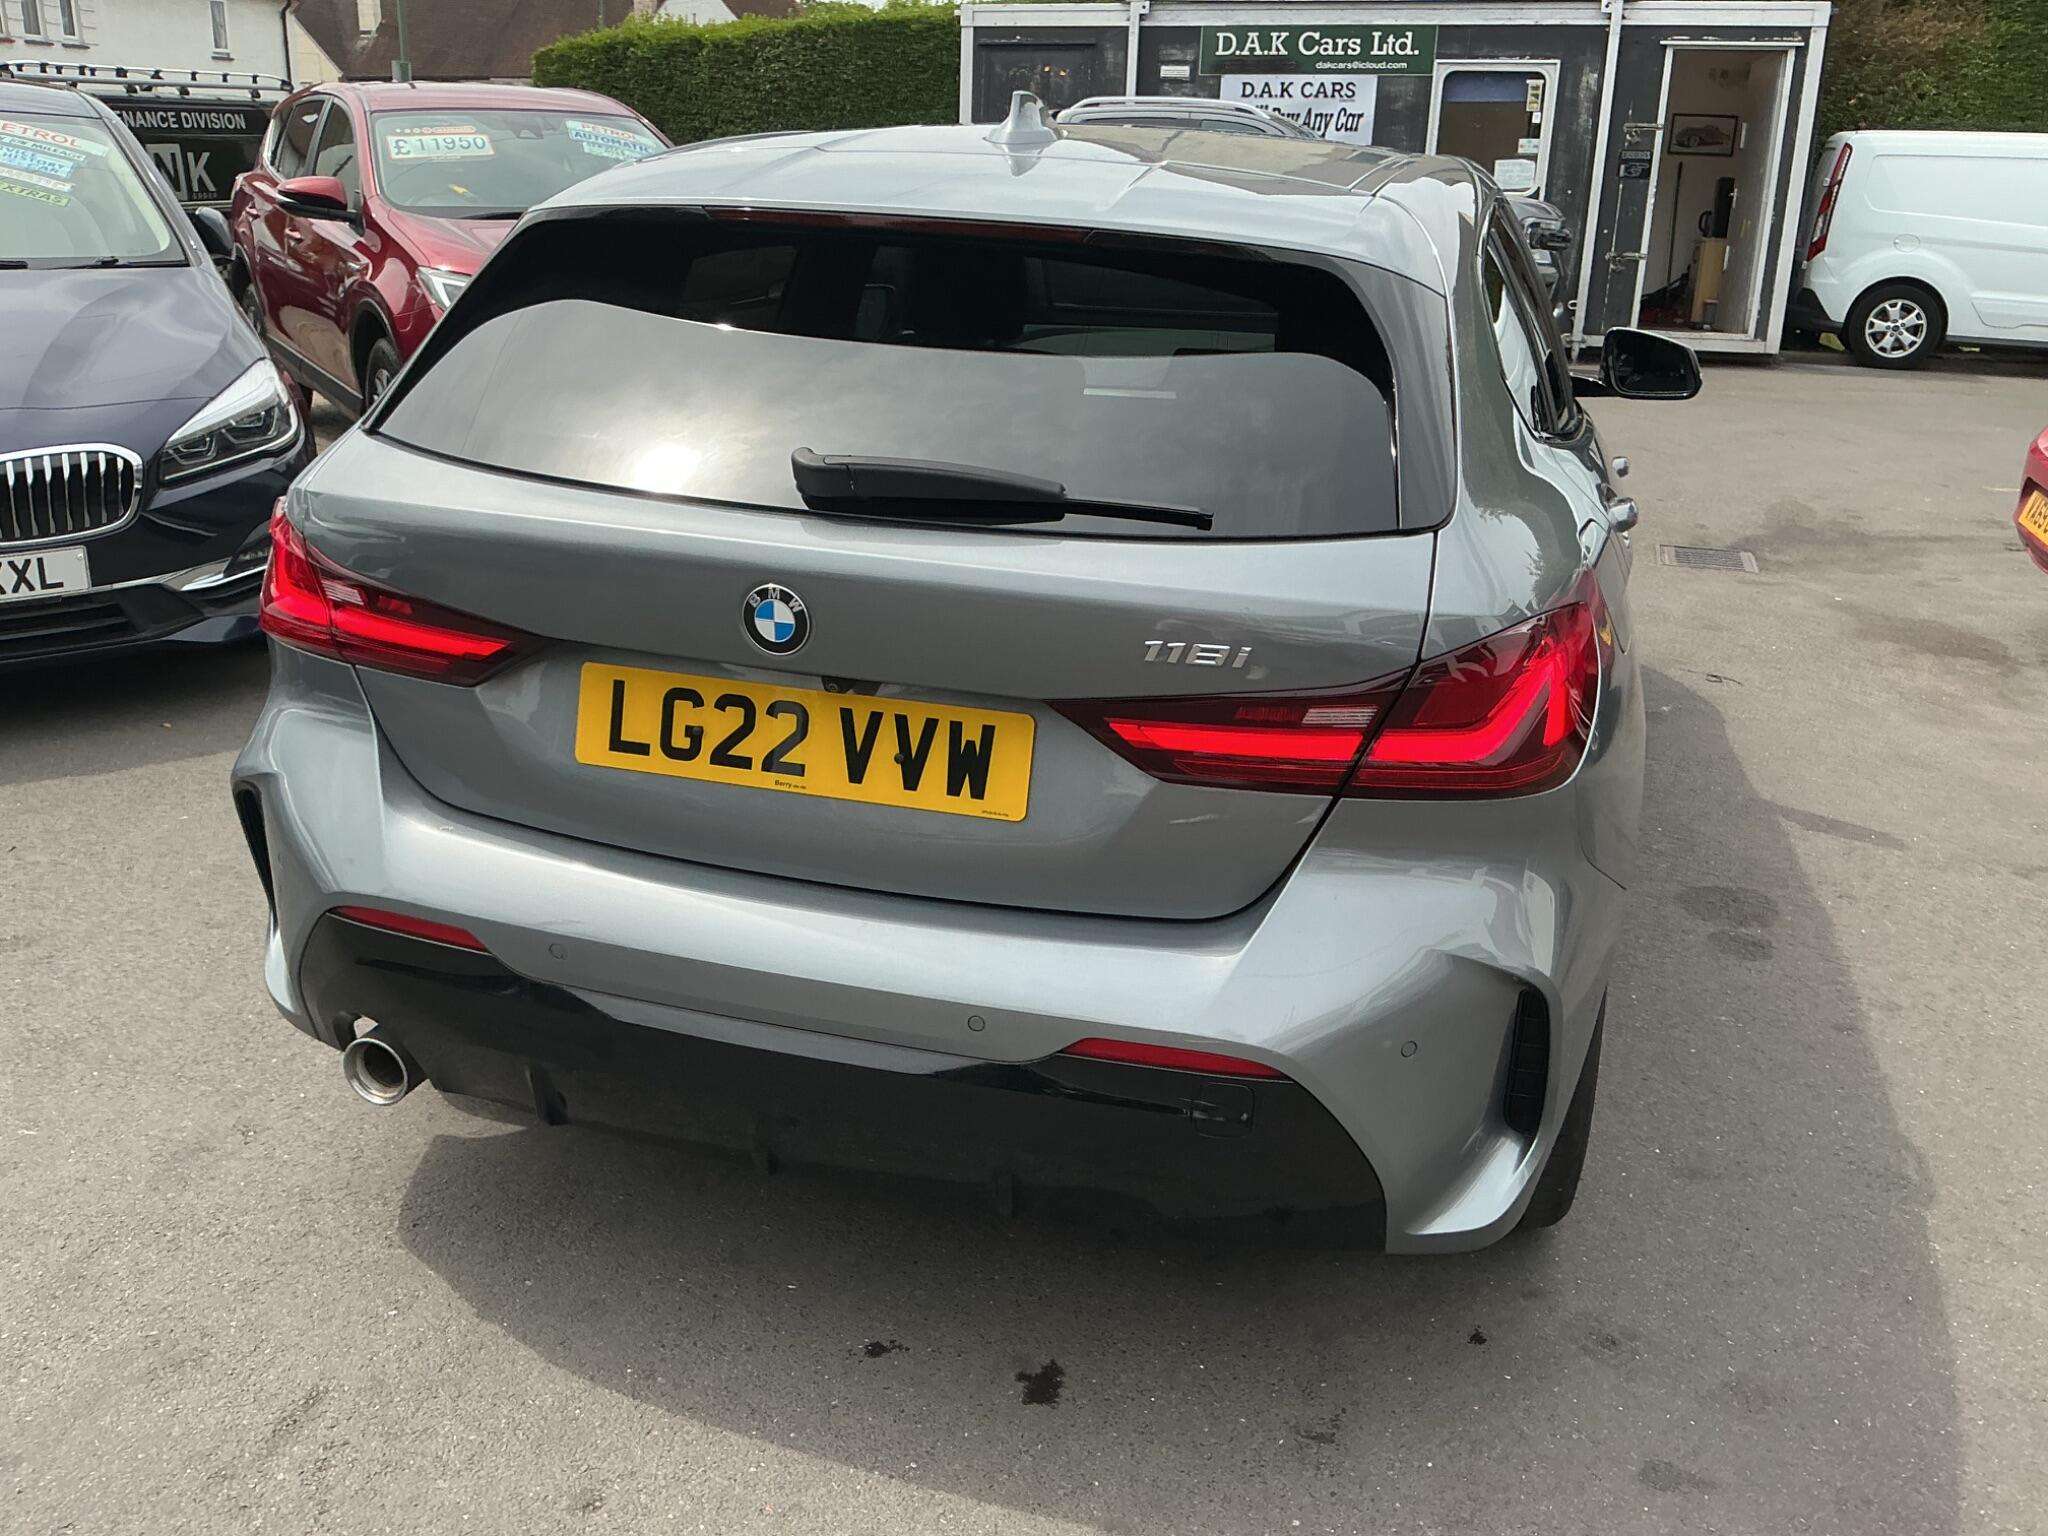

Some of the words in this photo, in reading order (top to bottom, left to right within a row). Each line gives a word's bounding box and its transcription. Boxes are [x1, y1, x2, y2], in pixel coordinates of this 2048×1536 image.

[1215, 32, 1289, 56] D.A.K
[1298, 32, 1361, 56] Cars
[1370, 31, 1420, 56] Ltd.
[1315, 60, 1408, 70] dakcars@icloud.com
[1241, 82, 1293, 99] D.A.K
[1300, 82, 1357, 99] CARS
[181, 112, 246, 130] DIVISION
[1299, 107, 1334, 138] Any
[1335, 107, 1364, 132] Car
[574, 131, 651, 154] AUTOMATIC
[748, 586, 803, 612] BMW
[1144, 640, 1252, 668] 118i
[609, 680, 809, 777] LG22
[840, 707, 996, 800] VVW
